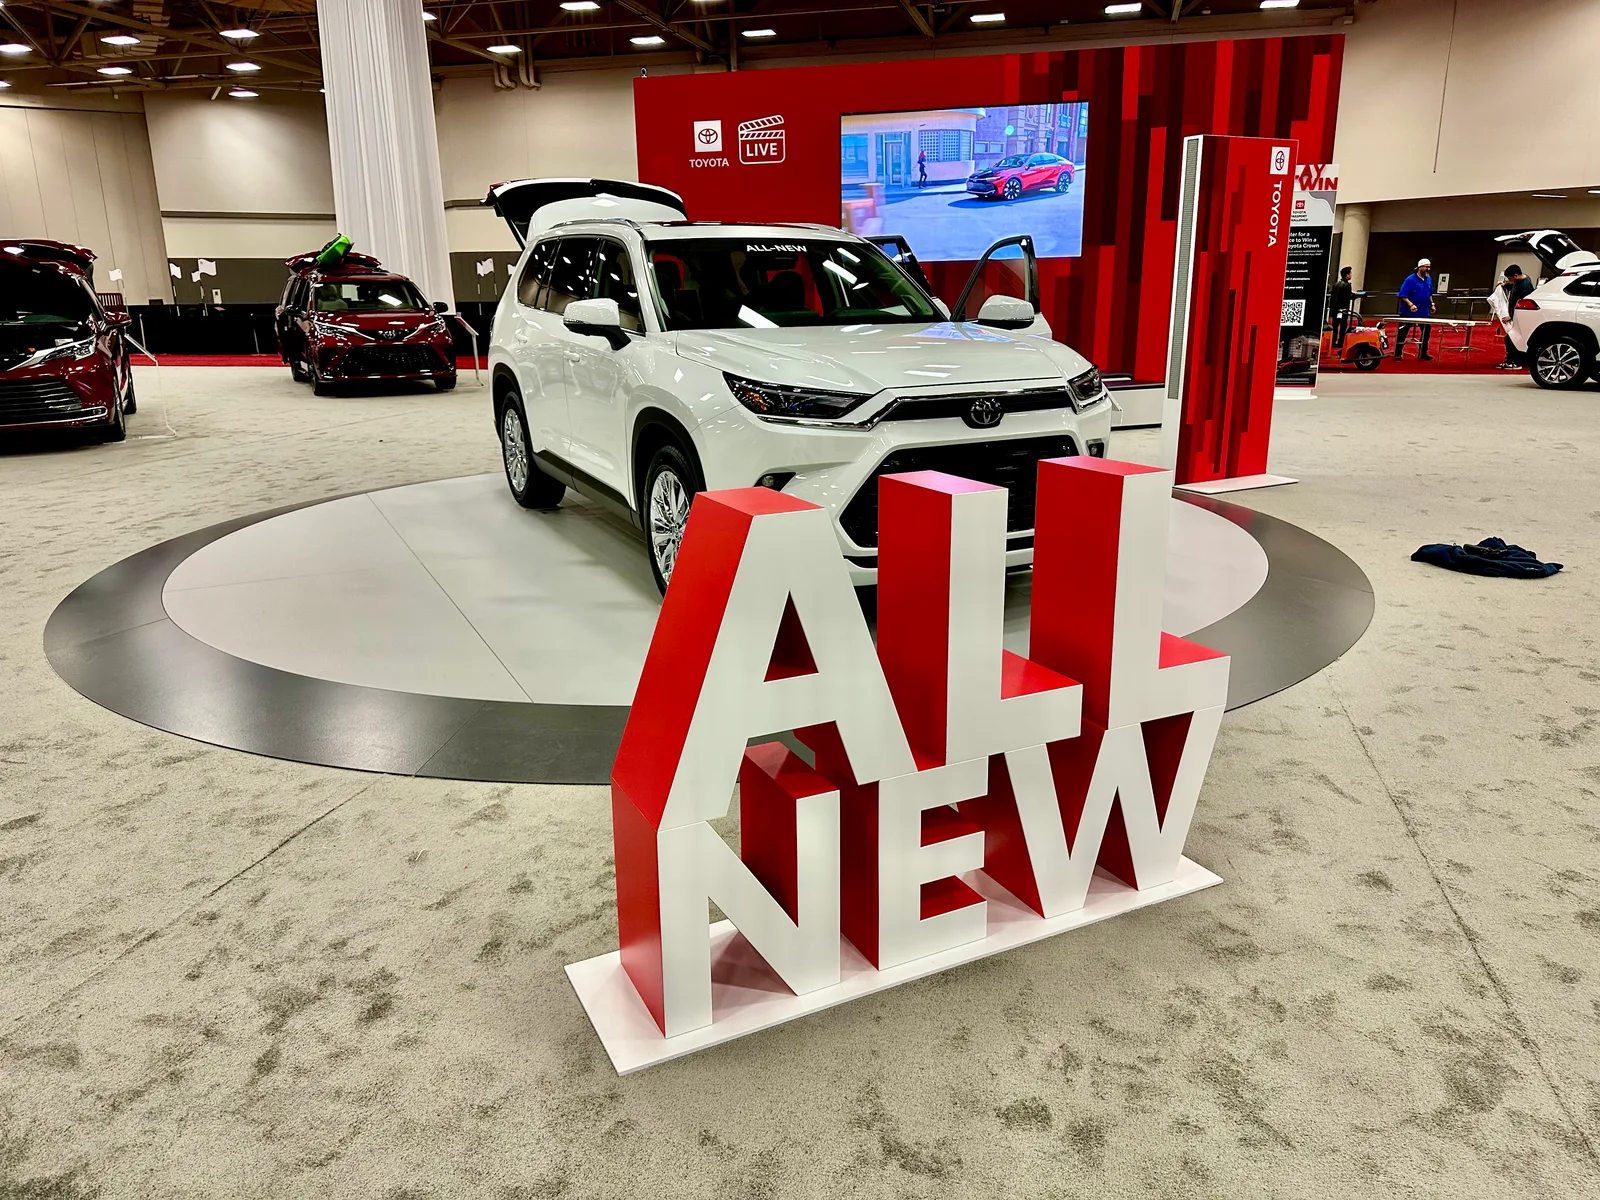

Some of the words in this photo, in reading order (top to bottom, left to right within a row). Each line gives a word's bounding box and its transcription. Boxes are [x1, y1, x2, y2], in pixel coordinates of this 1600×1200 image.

[746, 142, 778, 157] LIVE
[689, 157, 730, 168] TOYOTA
[1295, 163, 1327, 179] AY
[1299, 177, 1338, 190] WIN
[1267, 180, 1283, 248] TOYOTA
[746, 244, 808, 253] ALL-NEW
[650, 465, 1231, 833] ALL
[650, 703, 1228, 1040] NEW
